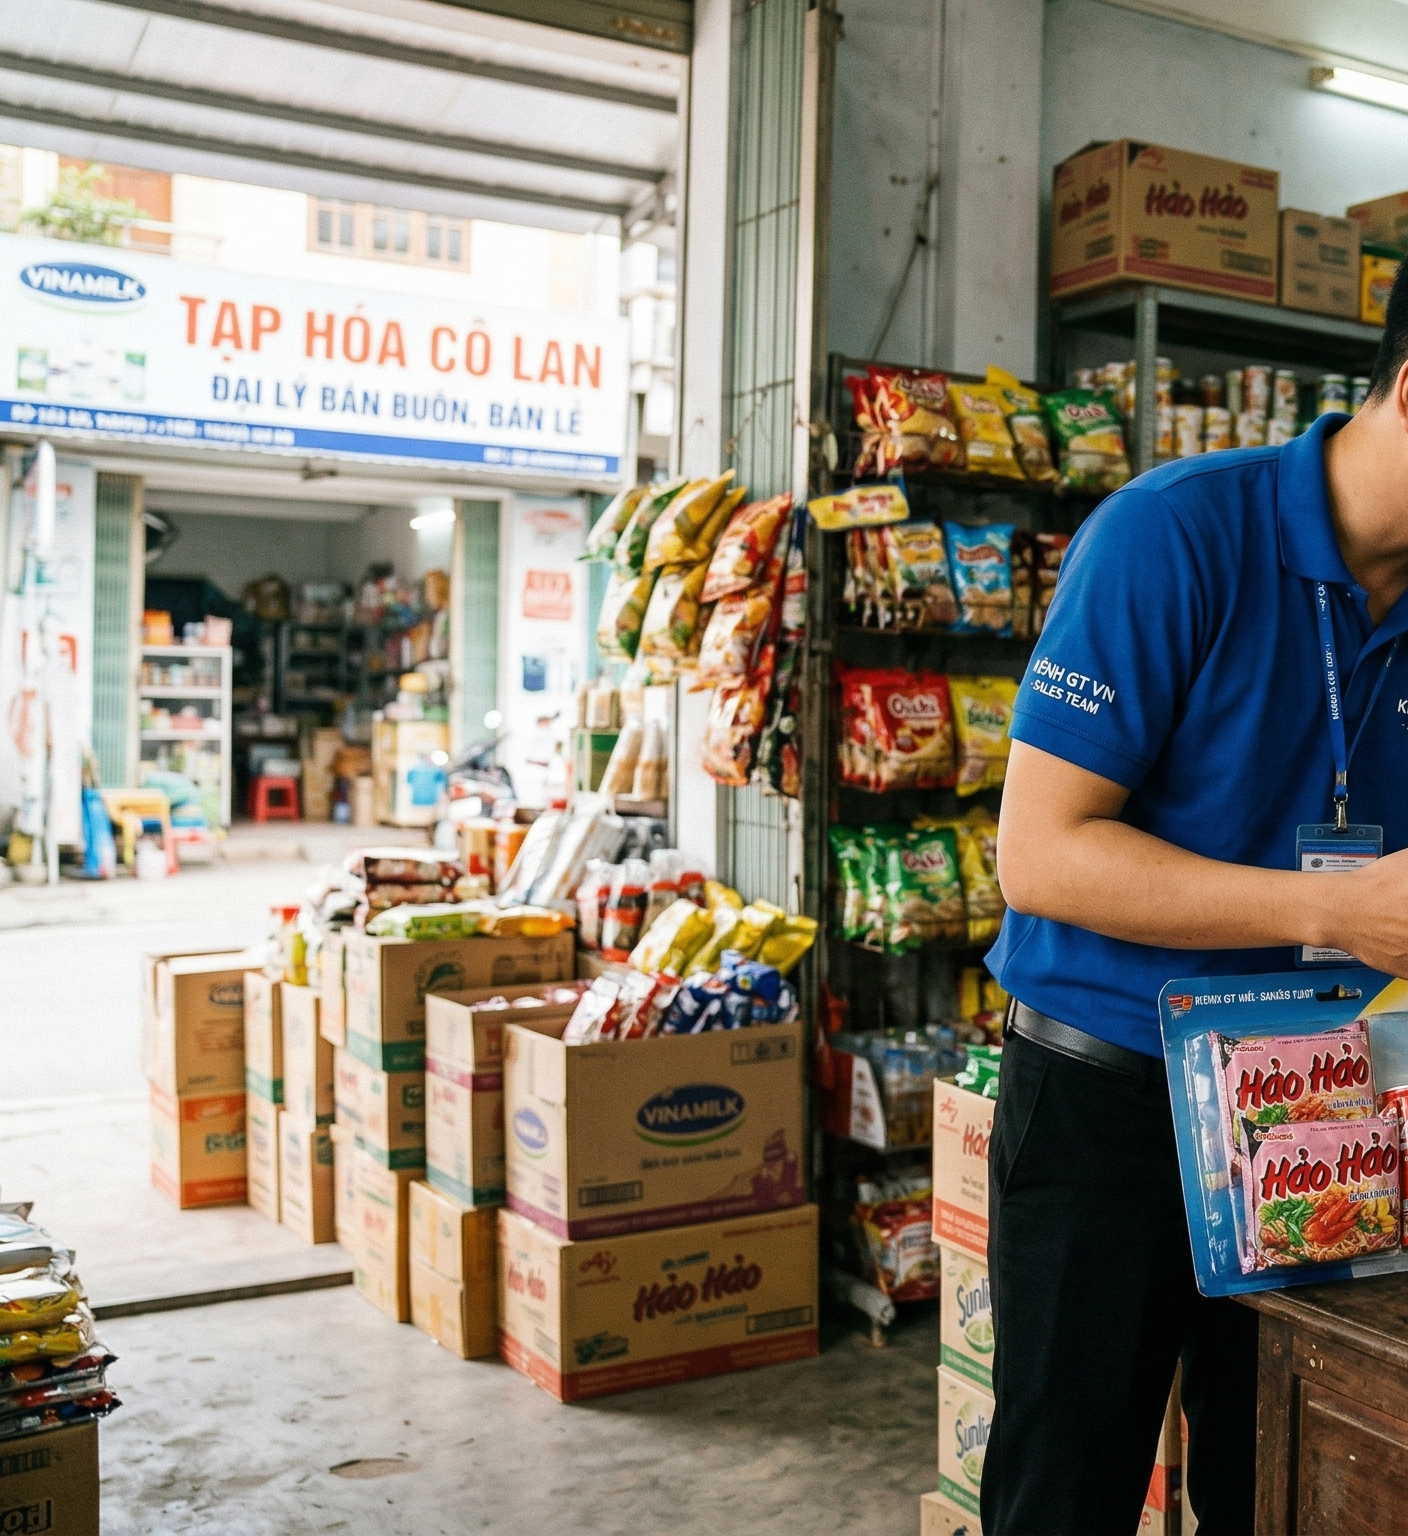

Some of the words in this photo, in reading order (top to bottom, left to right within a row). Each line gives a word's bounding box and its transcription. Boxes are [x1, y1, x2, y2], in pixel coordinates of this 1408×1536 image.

[25, 265, 143, 301] VINAMILK
[179, 295, 281, 362] TẠP
[305, 301, 407, 368] HÓA
[430, 317, 492, 377] CÔ
[513, 336, 602, 389] LAN
[212, 375, 261, 412] ĐẠI
[1065, 691, 1100, 715] TEAM
[1066, 671, 1091, 691] GT
[1092, 680, 1116, 704] VN
[1223, 993, 1236, 1004] GT
[1236, 1057, 1306, 1111] Hảo
[1308, 1043, 1370, 1094] Hảo
[642, 1097, 740, 1126] VINAMILK
[1260, 1147, 1333, 1201] Hảo
[1335, 1131, 1399, 1186] Hảo
